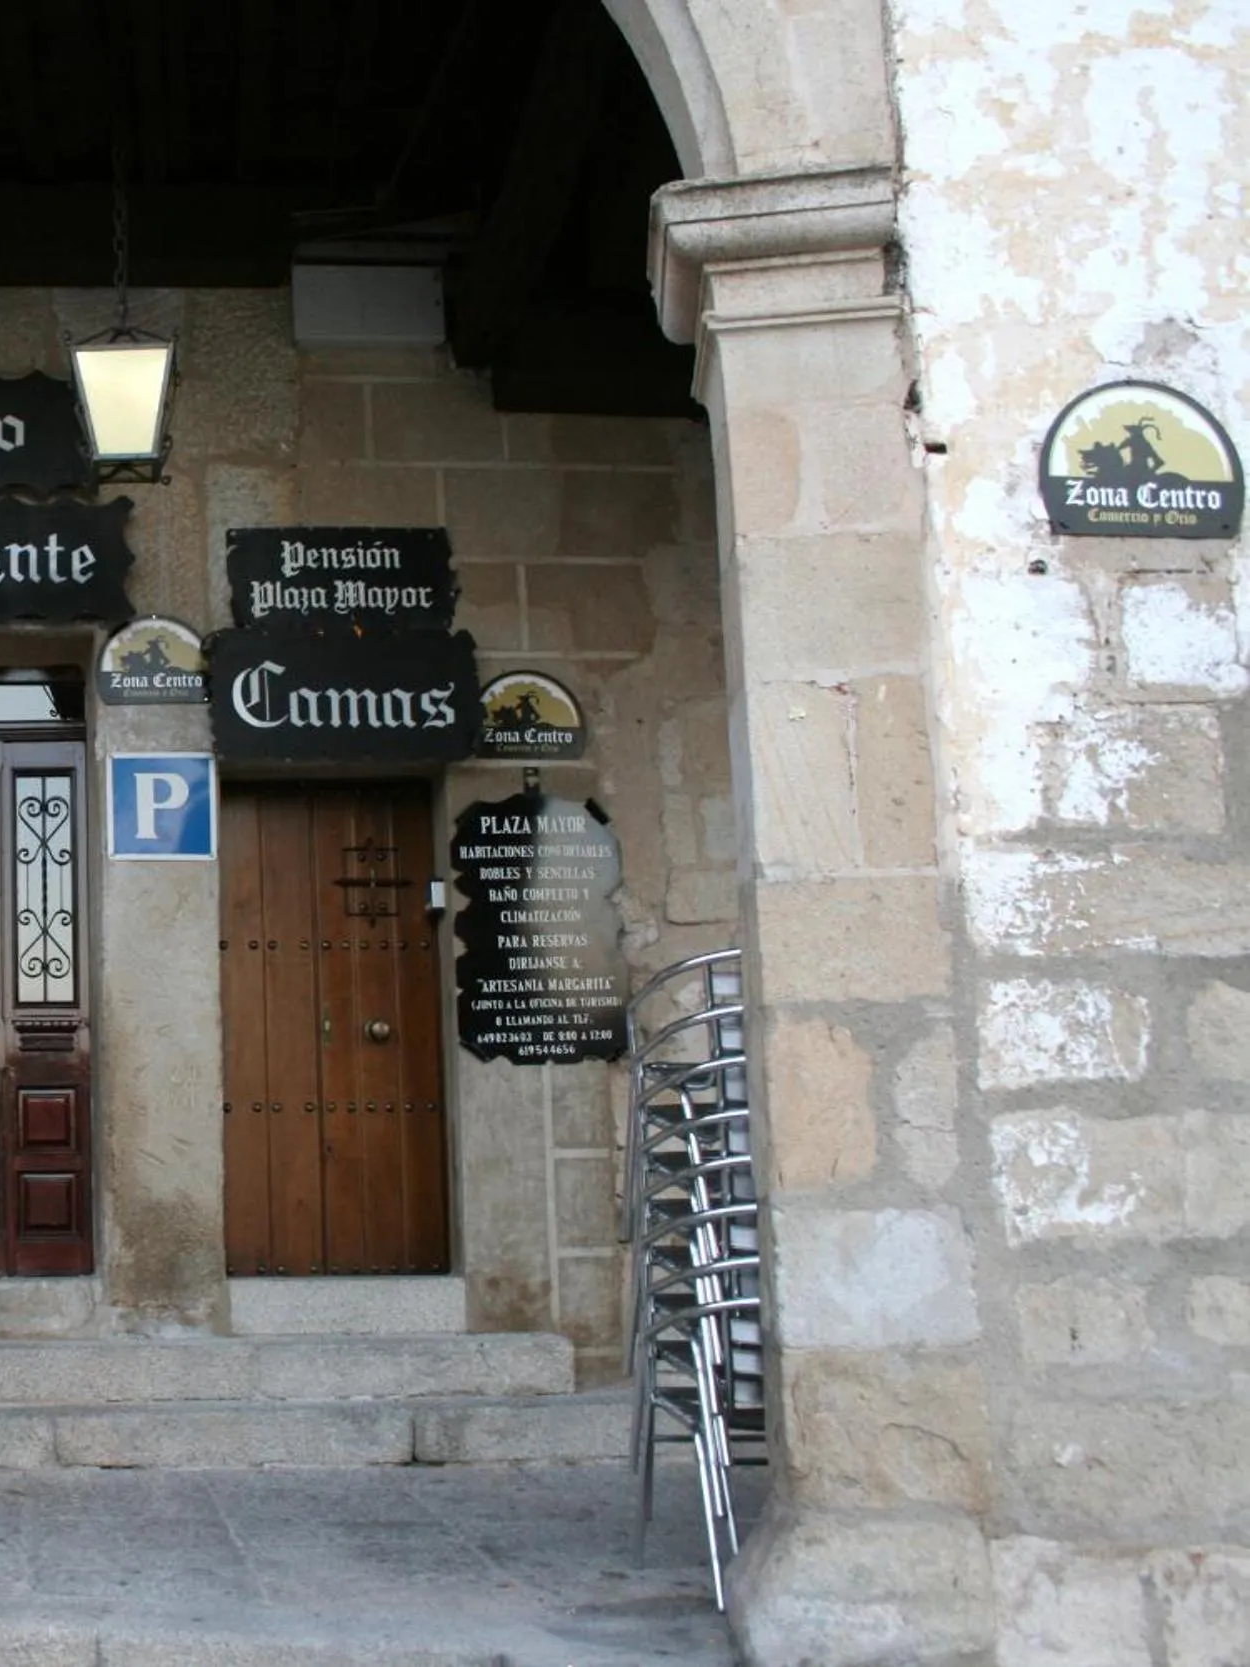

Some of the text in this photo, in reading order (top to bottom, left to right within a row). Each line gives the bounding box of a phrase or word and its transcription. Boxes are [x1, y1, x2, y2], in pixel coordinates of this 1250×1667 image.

[1065, 480, 1221, 510] Zona Centro
[280, 541, 401, 577] Pensión
[251, 579, 433, 618] Plaza Mayor
[110, 672, 203, 688] Zona Centro
[232, 660, 456, 728] Camas
[485, 727, 573, 744] Zona Centro
[133, 773, 189, 840] P
[480, 815, 587, 835] PLAZA MAYOR
[459, 846, 534, 859] HABITACIONES
[526, 866, 533, 880] Y
[489, 885, 518, 902] BAÑO
[497, 934, 588, 949] PARA RESERVAS
